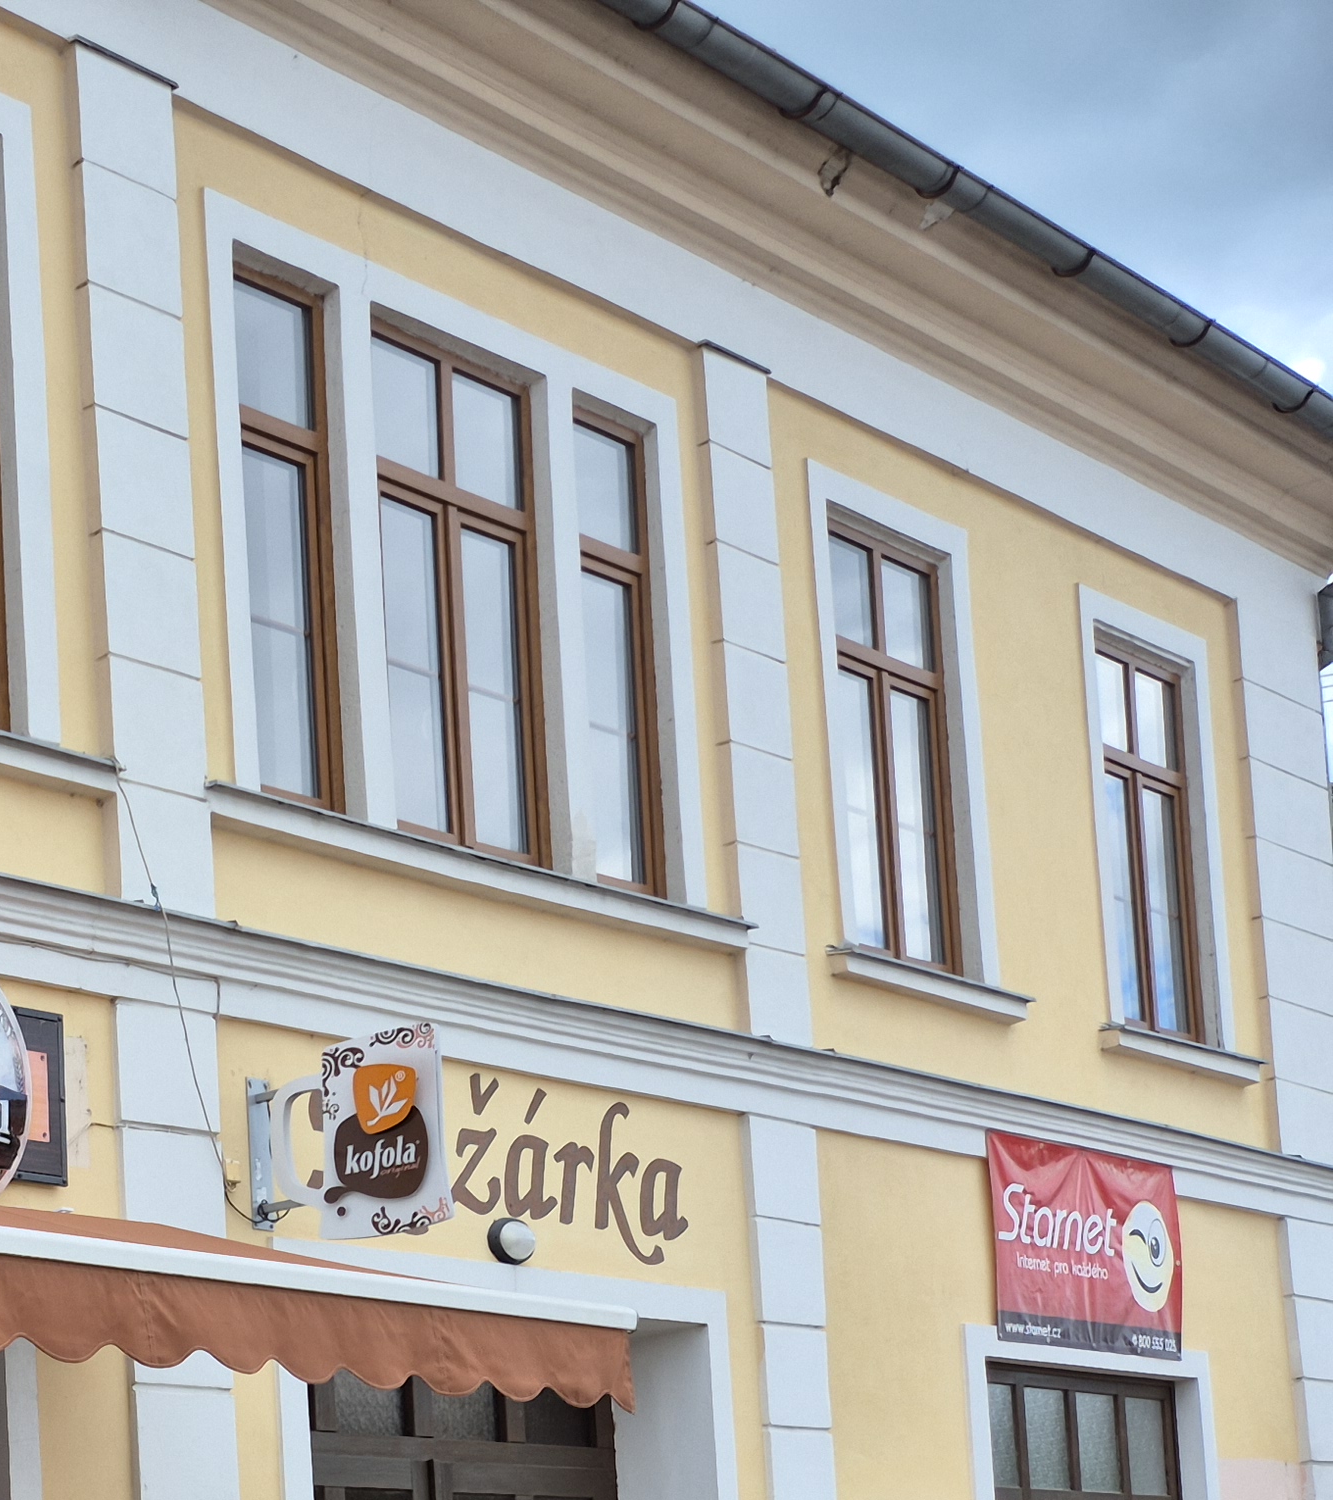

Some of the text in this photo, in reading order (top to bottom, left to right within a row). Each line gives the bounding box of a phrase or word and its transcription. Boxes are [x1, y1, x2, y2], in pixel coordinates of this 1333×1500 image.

[307, 1073, 688, 1265] žárka
[345, 1135, 416, 1179] kofola
[998, 1182, 1117, 1256] Starnet
[1016, 1252, 1050, 1272] Internet
[1054, 1262, 1069, 1277] pro
